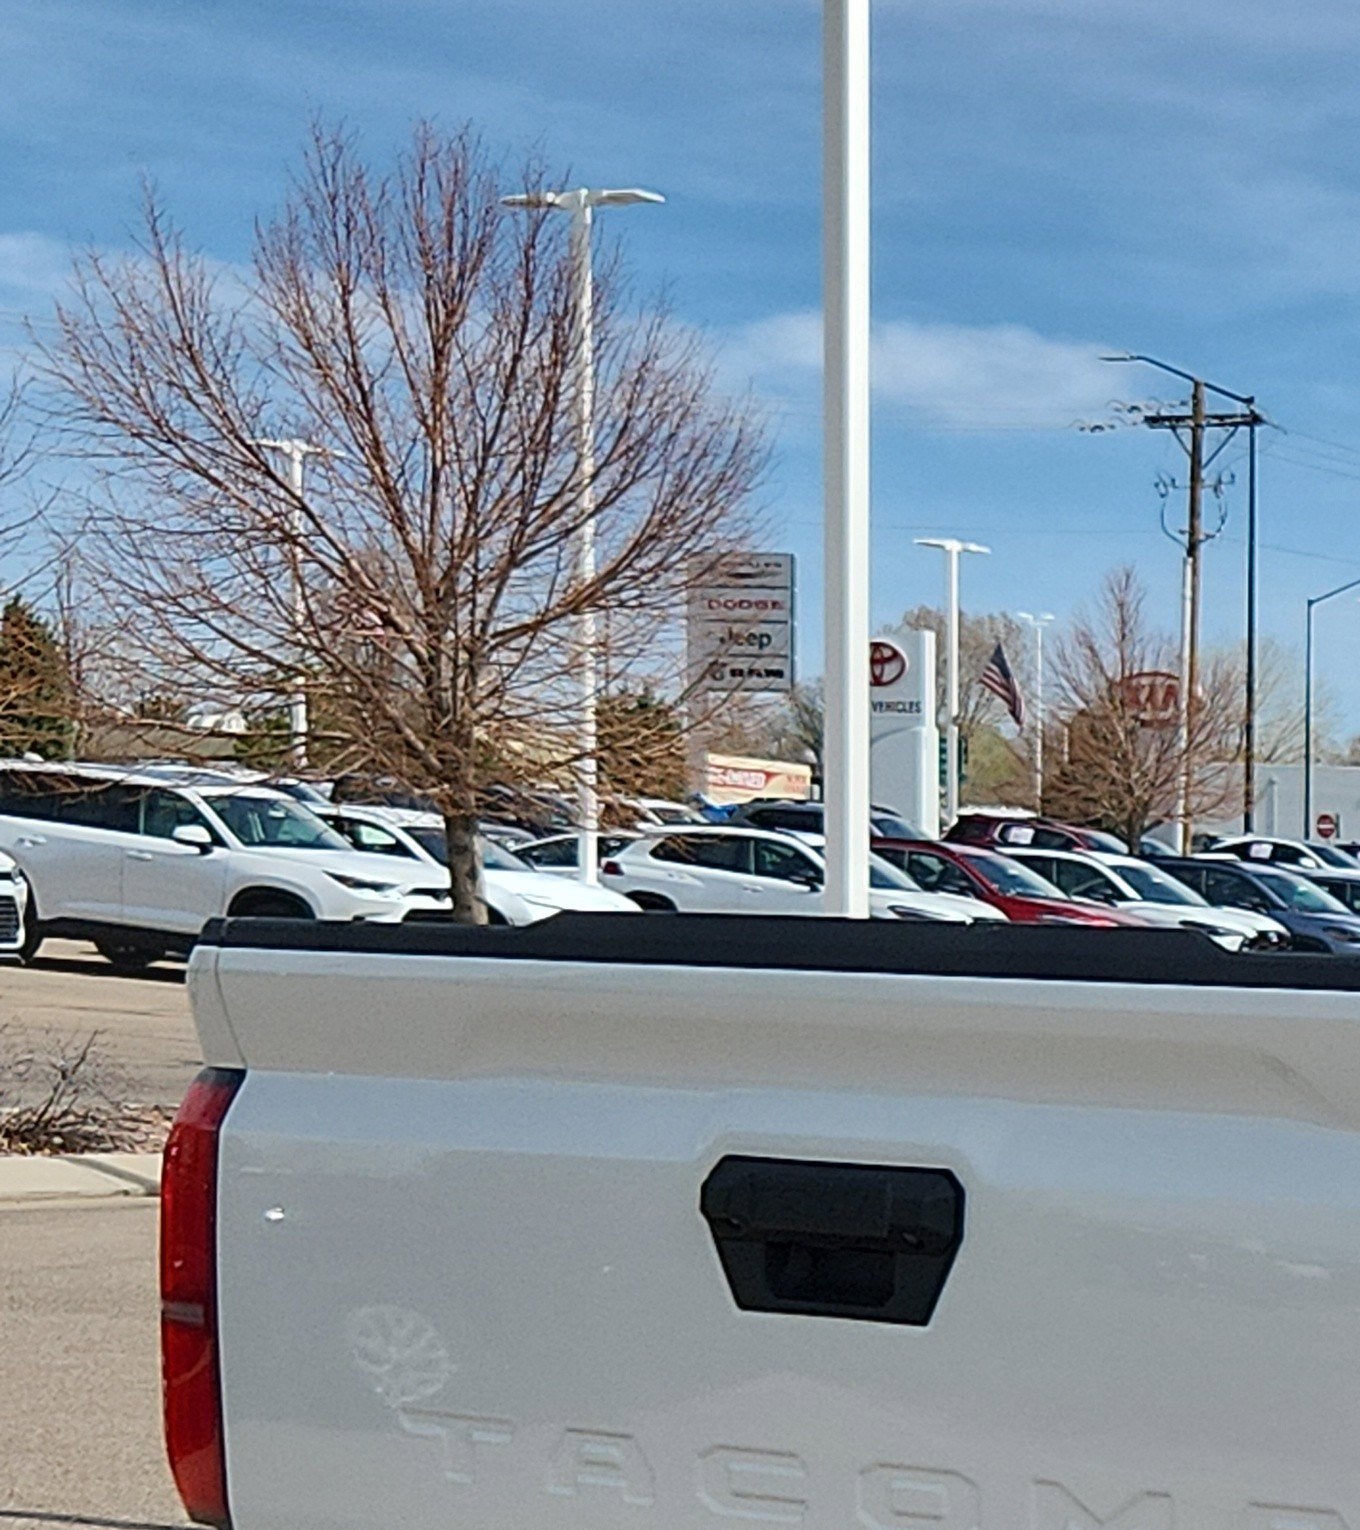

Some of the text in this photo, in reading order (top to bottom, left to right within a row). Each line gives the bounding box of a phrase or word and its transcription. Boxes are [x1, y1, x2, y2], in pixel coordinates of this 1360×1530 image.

[708, 599, 784, 610] DODGE
[719, 626, 772, 650] Jeep
[871, 700, 922, 713] VEHICLES
